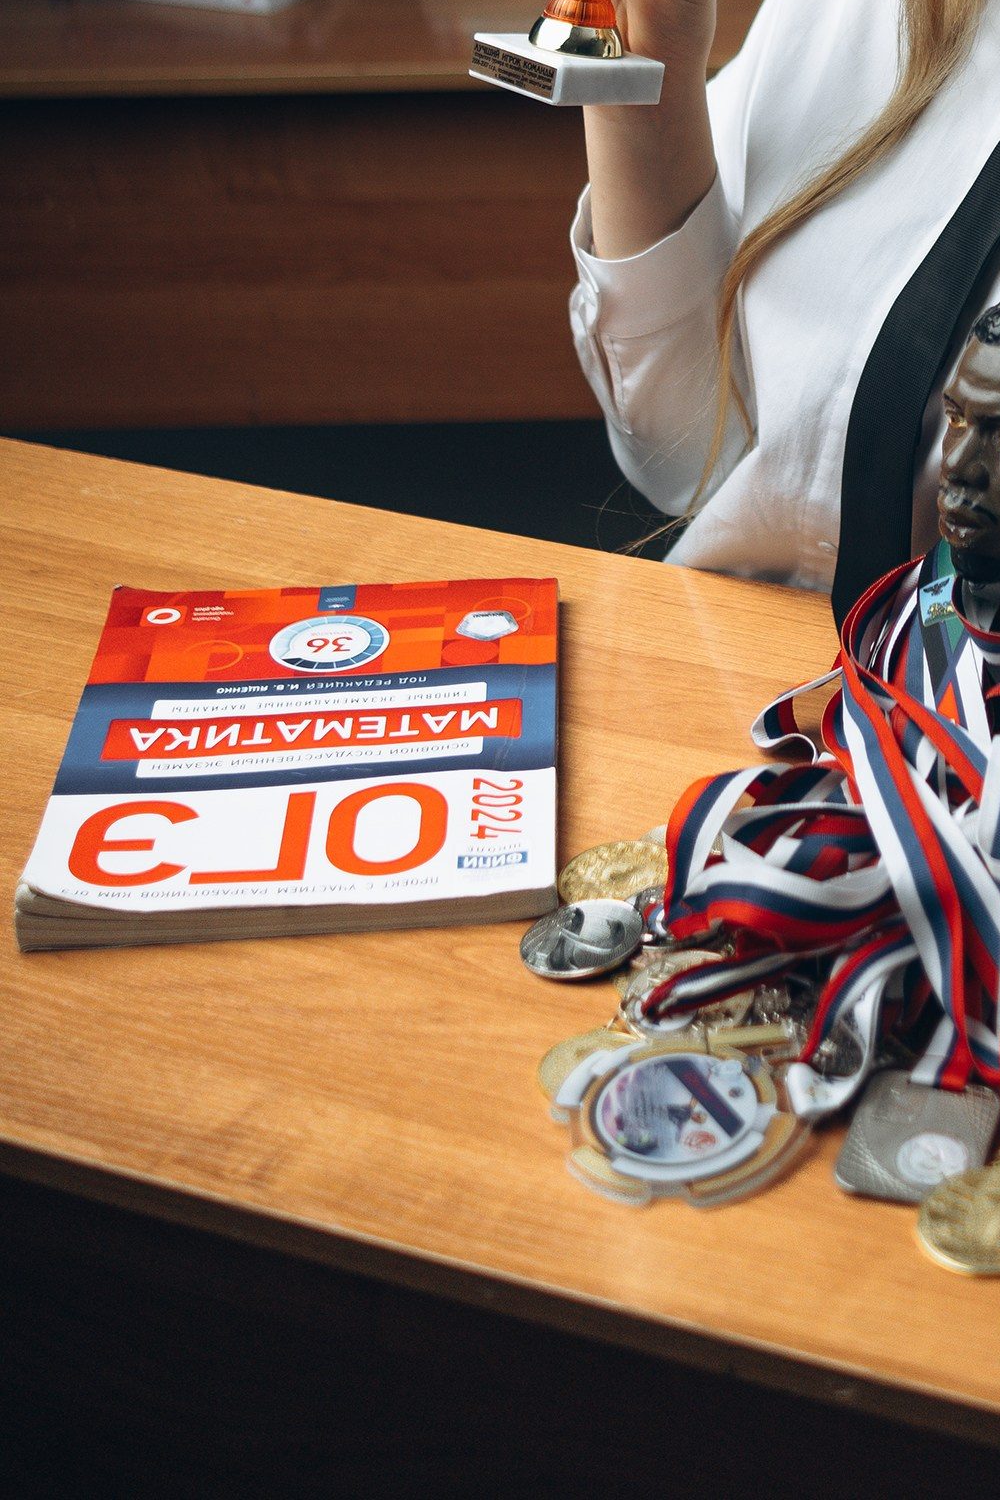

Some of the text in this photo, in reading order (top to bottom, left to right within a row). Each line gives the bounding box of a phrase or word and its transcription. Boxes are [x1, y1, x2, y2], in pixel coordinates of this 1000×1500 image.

[501, 52, 522, 67] ИГРОК
[523, 60, 555, 78] КОМАНДЫ
[306, 636, 353, 654] 36
[215, 684, 269, 695] ЯЩЕНКО
[287, 683, 300, 691] И.
[305, 678, 392, 690] РЕДАКЦИЕЙ
[398, 676, 427, 685] ПОД
[171, 690, 468, 714] ТИПОВЫЕ ЭКЗАМЕНАЦИОННЫЕ ВАРИАНТЫ
[129, 707, 499, 751] МАТЕМАТИКА
[151, 741, 470, 771] ОСНОВНОЙ ГОСУДАРСТВЕННЫЙ ЭКЗАМЕН
[470, 777, 523, 841] 2024
[68, 782, 449, 887] ОГЭ
[463, 853, 523, 869] ФИПИ
[60, 876, 440, 899] ПРОЕКТ С УЧАСТИЕМ РАЗРАБОТЧИКОВ КИМ ОГЭ
